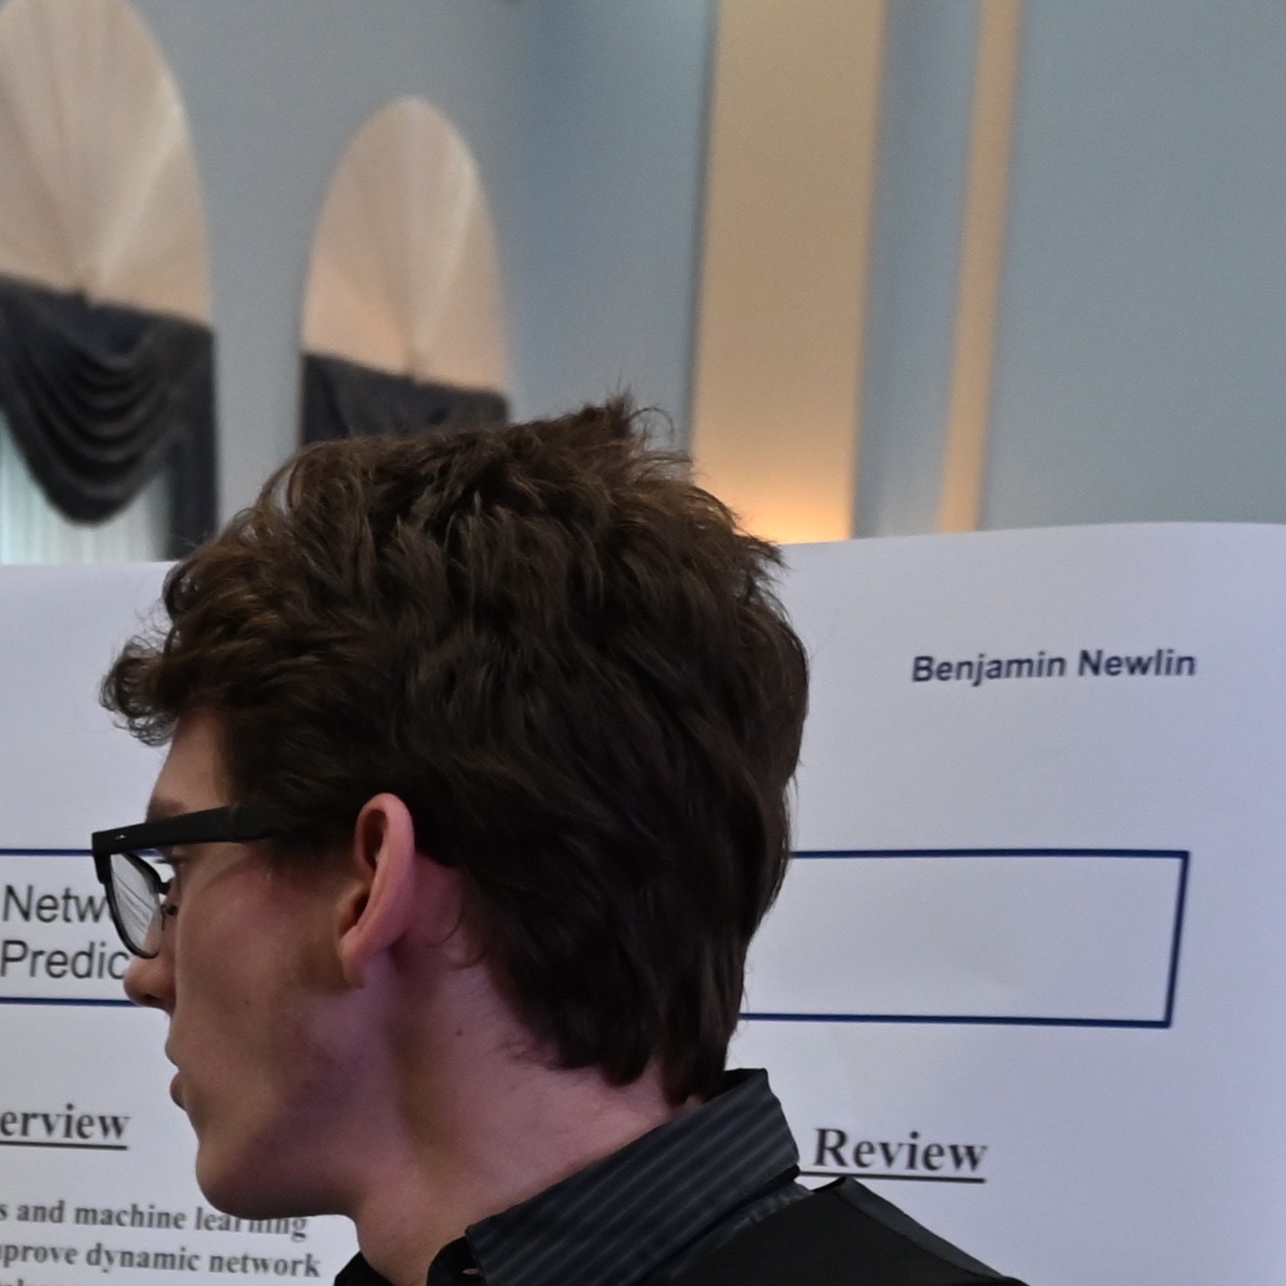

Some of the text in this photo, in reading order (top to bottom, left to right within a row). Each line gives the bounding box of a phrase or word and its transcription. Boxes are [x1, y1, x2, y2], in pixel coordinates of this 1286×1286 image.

[912, 648, 1197, 687] Benjamin Newlin
[3, 885, 110, 924] Netw
[0, 940, 128, 980] Predic
[813, 1128, 988, 1172] Review
[16, 1199, 65, 1225] and
[74, 1201, 186, 1231] machine
[86, 1242, 199, 1274] dynamic
[209, 1246, 321, 1279] network
